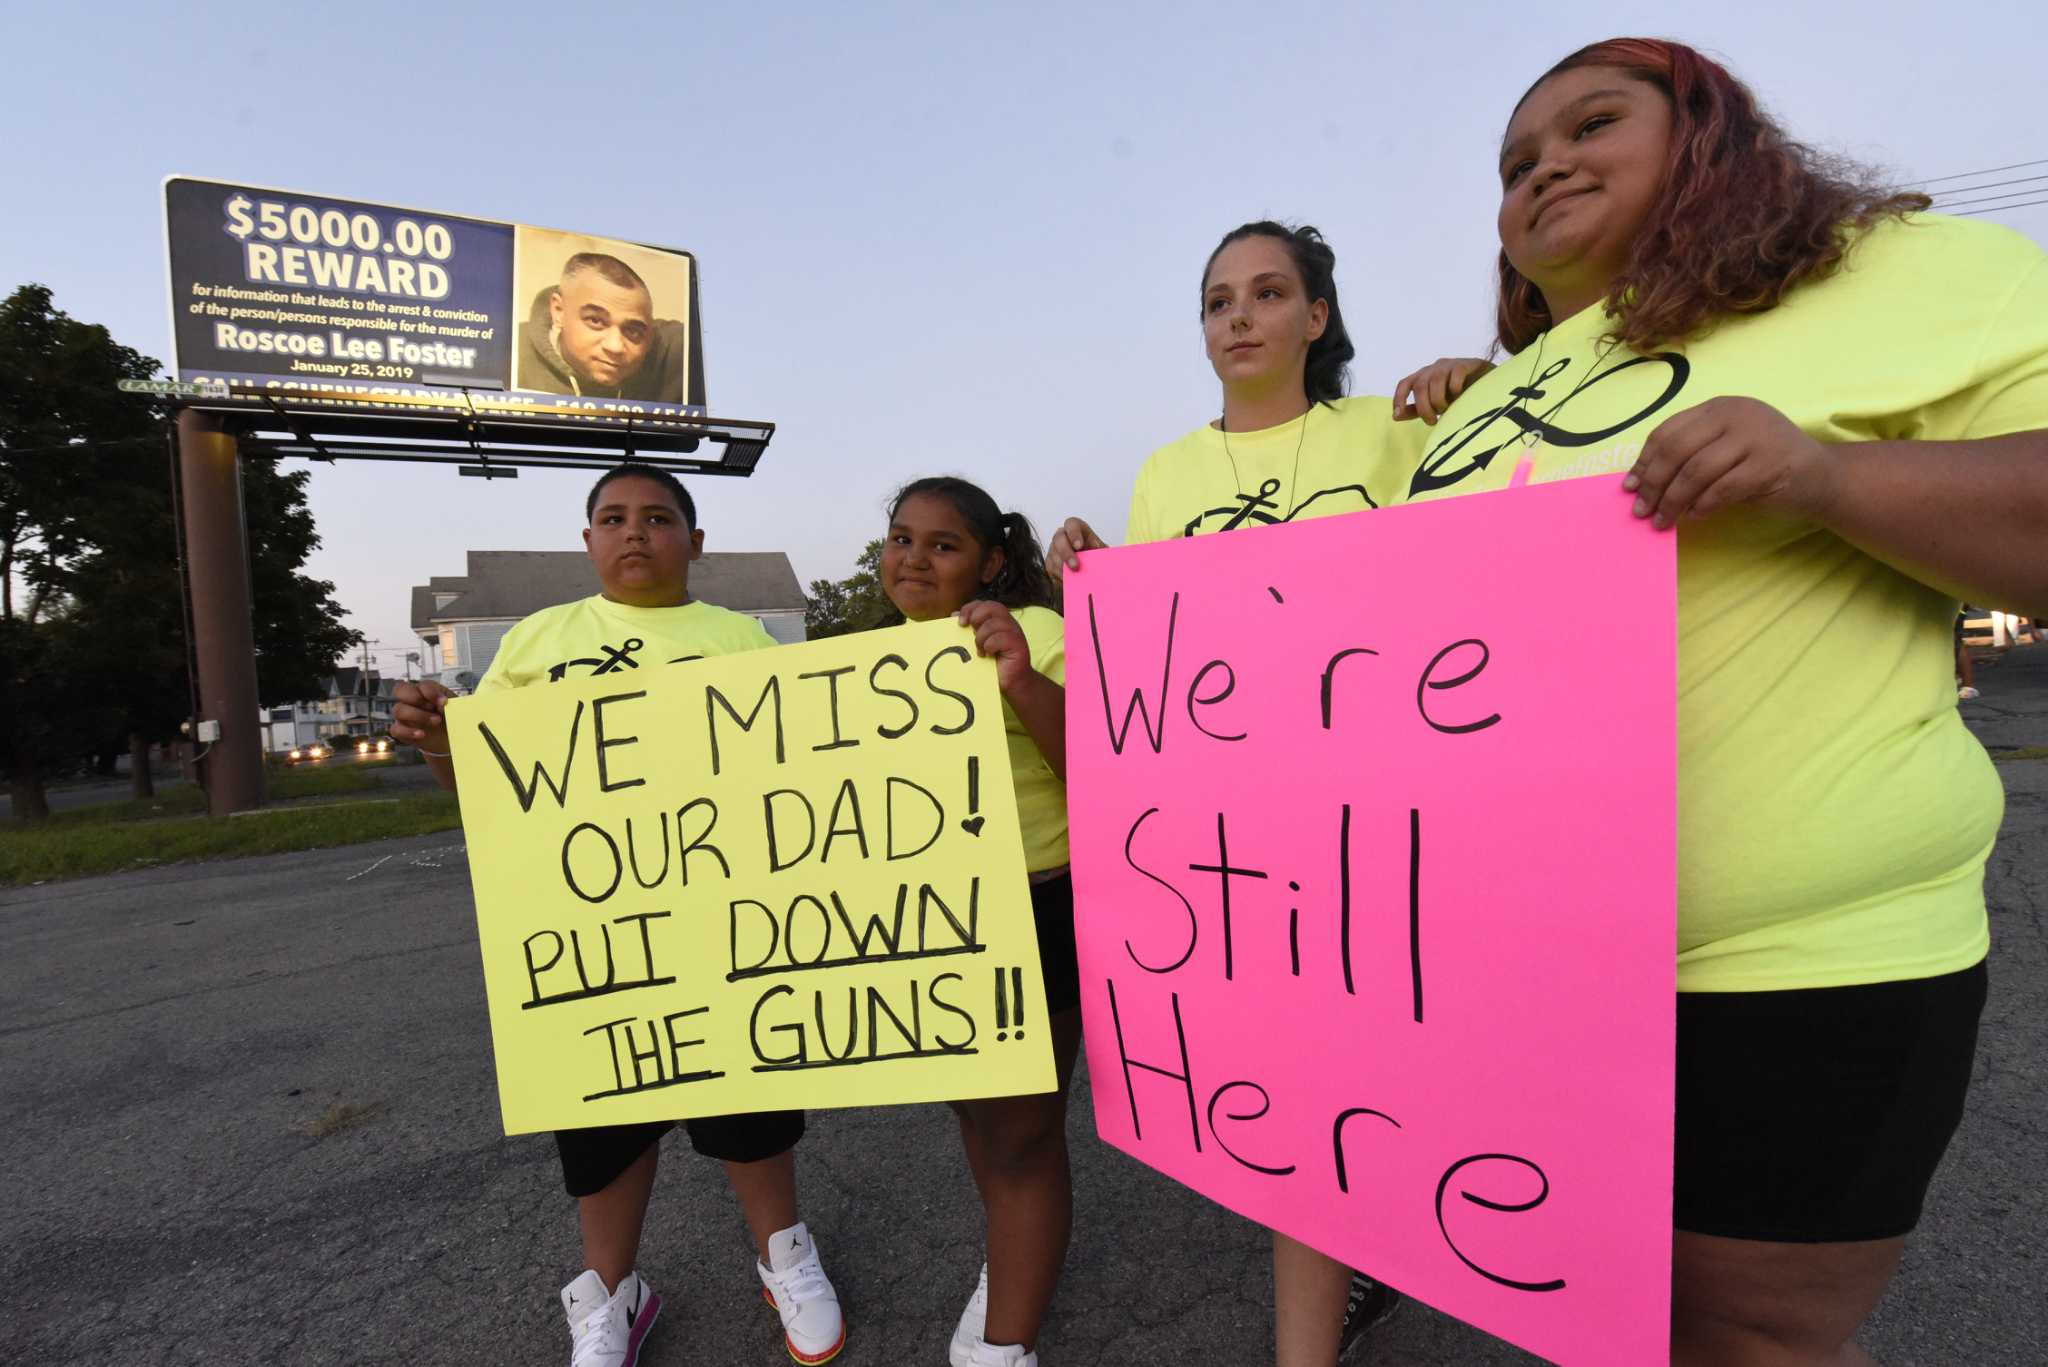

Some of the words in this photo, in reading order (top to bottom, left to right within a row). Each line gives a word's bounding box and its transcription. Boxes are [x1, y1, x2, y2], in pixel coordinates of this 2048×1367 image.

[227, 195, 452, 260] $5000.00
[247, 242, 449, 299] REWARD
[189, 302, 205, 315] of
[206, 303, 229, 316] the
[230, 306, 327, 324] person/persons
[329, 315, 397, 331] responsible
[399, 319, 416, 333] for
[418, 321, 436, 335] the
[438, 324, 480, 339] murder
[481, 327, 494, 341] of
[192, 282, 212, 296] for
[213, 285, 288, 303] information
[291, 292, 316, 306] that
[318, 294, 350, 309] leads
[352, 300, 365, 311] to
[366, 299, 386, 313] the
[388, 303, 420, 317] arrest
[422, 305, 431, 317] &
[433, 308, 488, 324] conviction
[215, 322, 326, 356] Roscoe
[331, 332, 383, 361] Lee
[388, 336, 476, 368] Foster
[124, 381, 195, 393] LAMAR
[290, 359, 349, 377] January
[351, 362, 374, 377] 25,
[376, 364, 414, 379] 2019
[1089, 586, 1501, 755] We're
[479, 690, 647, 812] WE
[705, 646, 976, 775] MISS
[562, 797, 730, 903] OUR
[762, 756, 985, 873] DAD!
[522, 911, 676, 1006] PUT
[728, 877, 984, 975] DOWN
[1125, 804, 1424, 1023] Still
[583, 1006, 716, 1096] THE
[748, 966, 1025, 1068] GUNS!!
[1107, 979, 1566, 1292] Here
